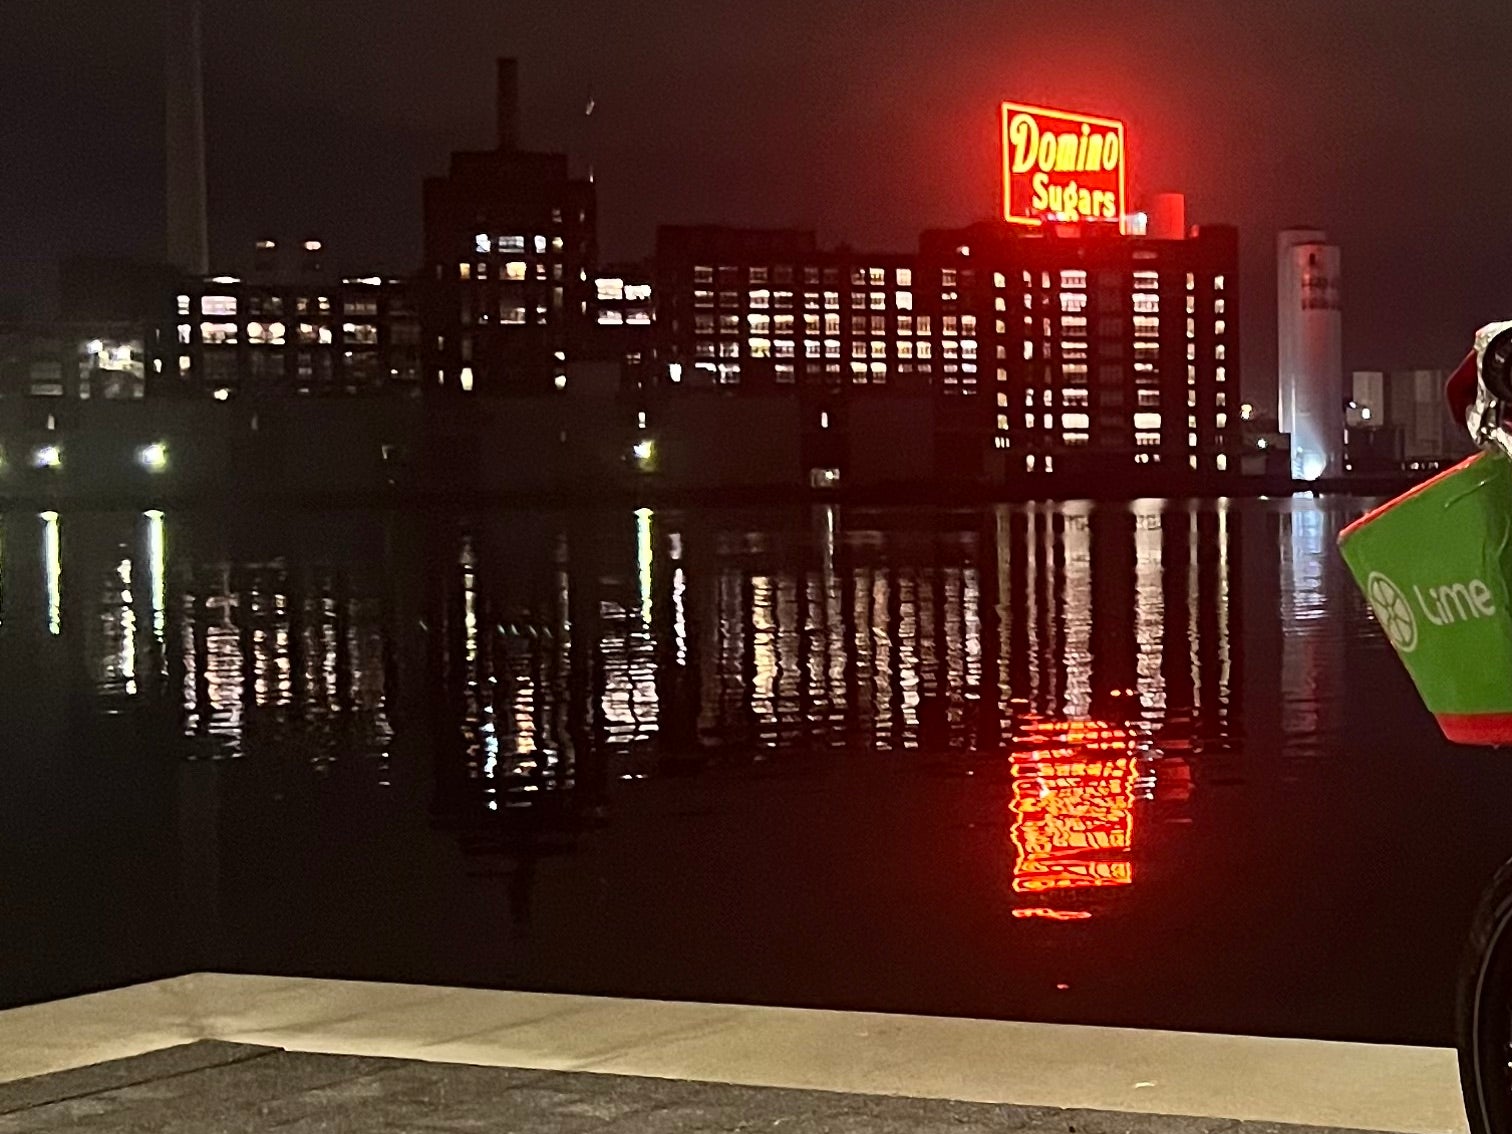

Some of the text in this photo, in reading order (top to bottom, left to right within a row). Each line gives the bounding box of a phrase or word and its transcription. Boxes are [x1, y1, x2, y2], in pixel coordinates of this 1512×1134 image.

[1010, 113, 1119, 173] Domino
[1032, 172, 1116, 222] Sugars
[1413, 578, 1497, 627] Lime
